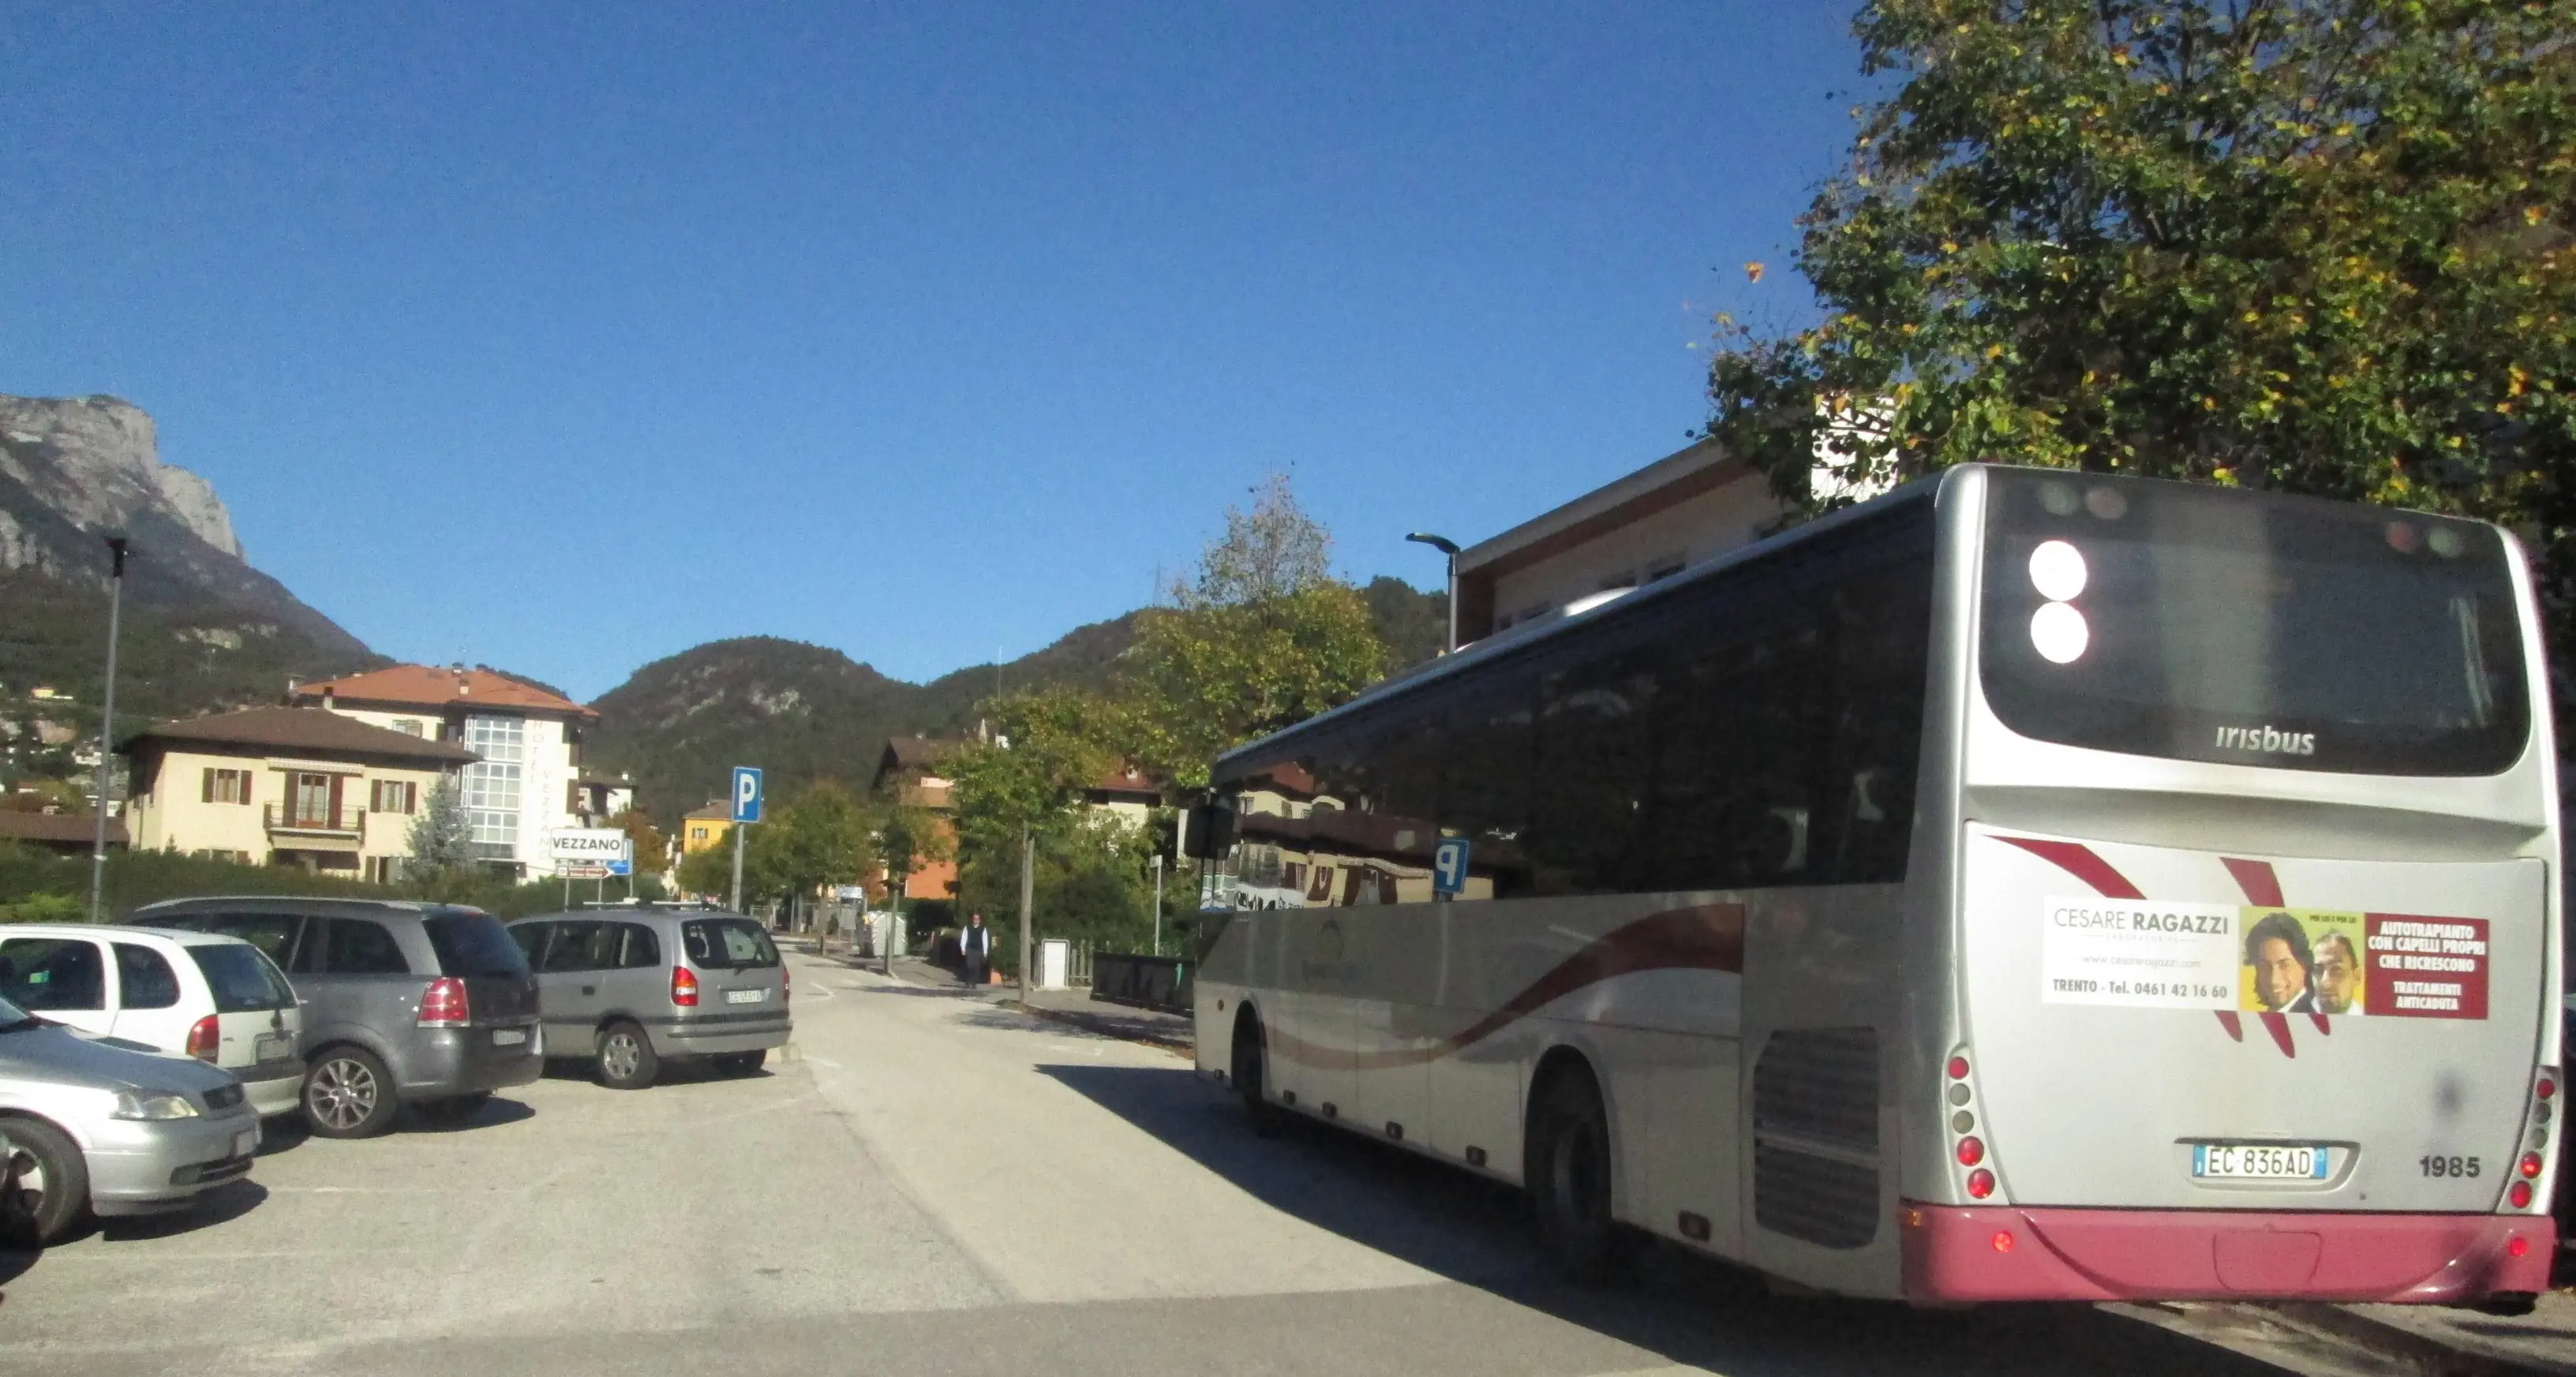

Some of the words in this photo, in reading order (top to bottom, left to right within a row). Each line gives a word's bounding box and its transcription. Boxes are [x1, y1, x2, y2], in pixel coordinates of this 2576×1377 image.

[738, 773, 755, 816] P
[552, 837, 620, 851] VEZZANO
[2054, 907, 2126, 930] CESARE
[2132, 911, 2229, 934] RAGAZZI
[2380, 921, 2475, 939] AUTOTRAPIANTO
[2368, 935, 2393, 950] CON
[2396, 937, 2439, 952] CAPELLI
[2443, 940, 2485, 955] PROPRI
[2379, 954, 2402, 969] CHE
[2404, 956, 2475, 971] RICRESCONO
[2054, 978, 2098, 993] TRENTO
[2109, 981, 2130, 994] Tel.
[2134, 982, 2166, 995] 0461
[2171, 984, 2188, 997] 42
[2193, 985, 2207, 997] 16
[2211, 986, 2227, 998] 60
[2393, 981, 2462, 996] TRATTAMENTI
[2396, 996, 2459, 1010] ANTICADUTA
[2209, 1147, 2234, 1173] EC
[2244, 1149, 2310, 1175] 836AD
[2419, 1154, 2481, 1178] 1985
